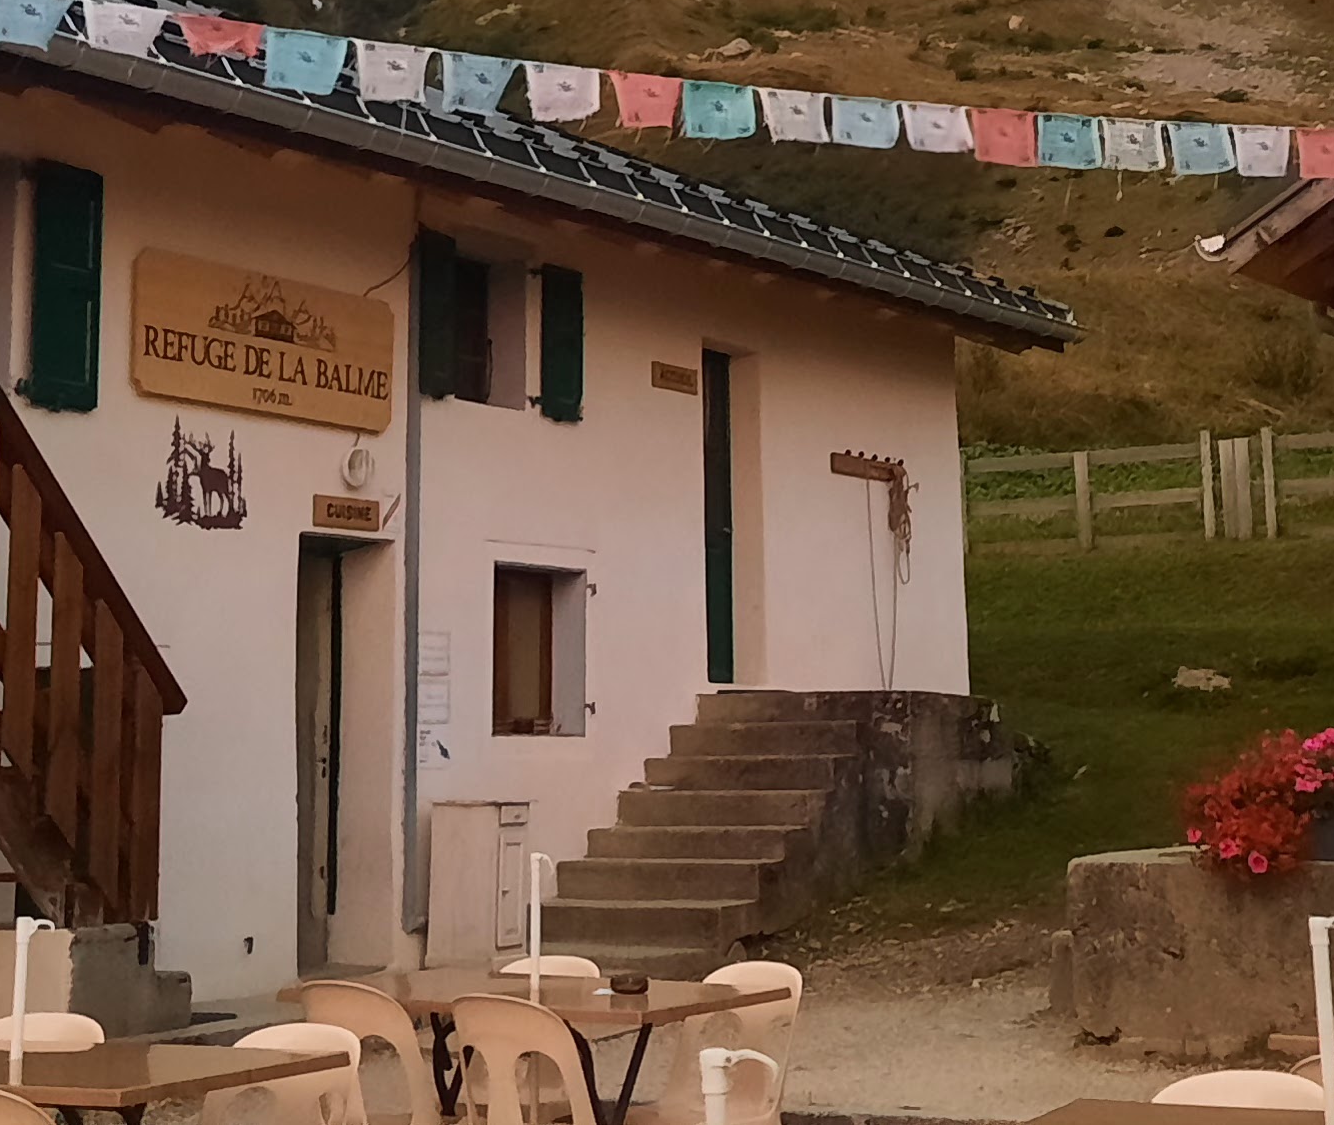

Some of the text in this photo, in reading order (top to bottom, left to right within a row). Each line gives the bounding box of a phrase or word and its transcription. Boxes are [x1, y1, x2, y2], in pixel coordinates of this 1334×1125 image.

[143, 324, 389, 401] REFUGE DE LA BALME
[252, 387, 276, 404] 1706
[327, 503, 372, 522] CUISINE
